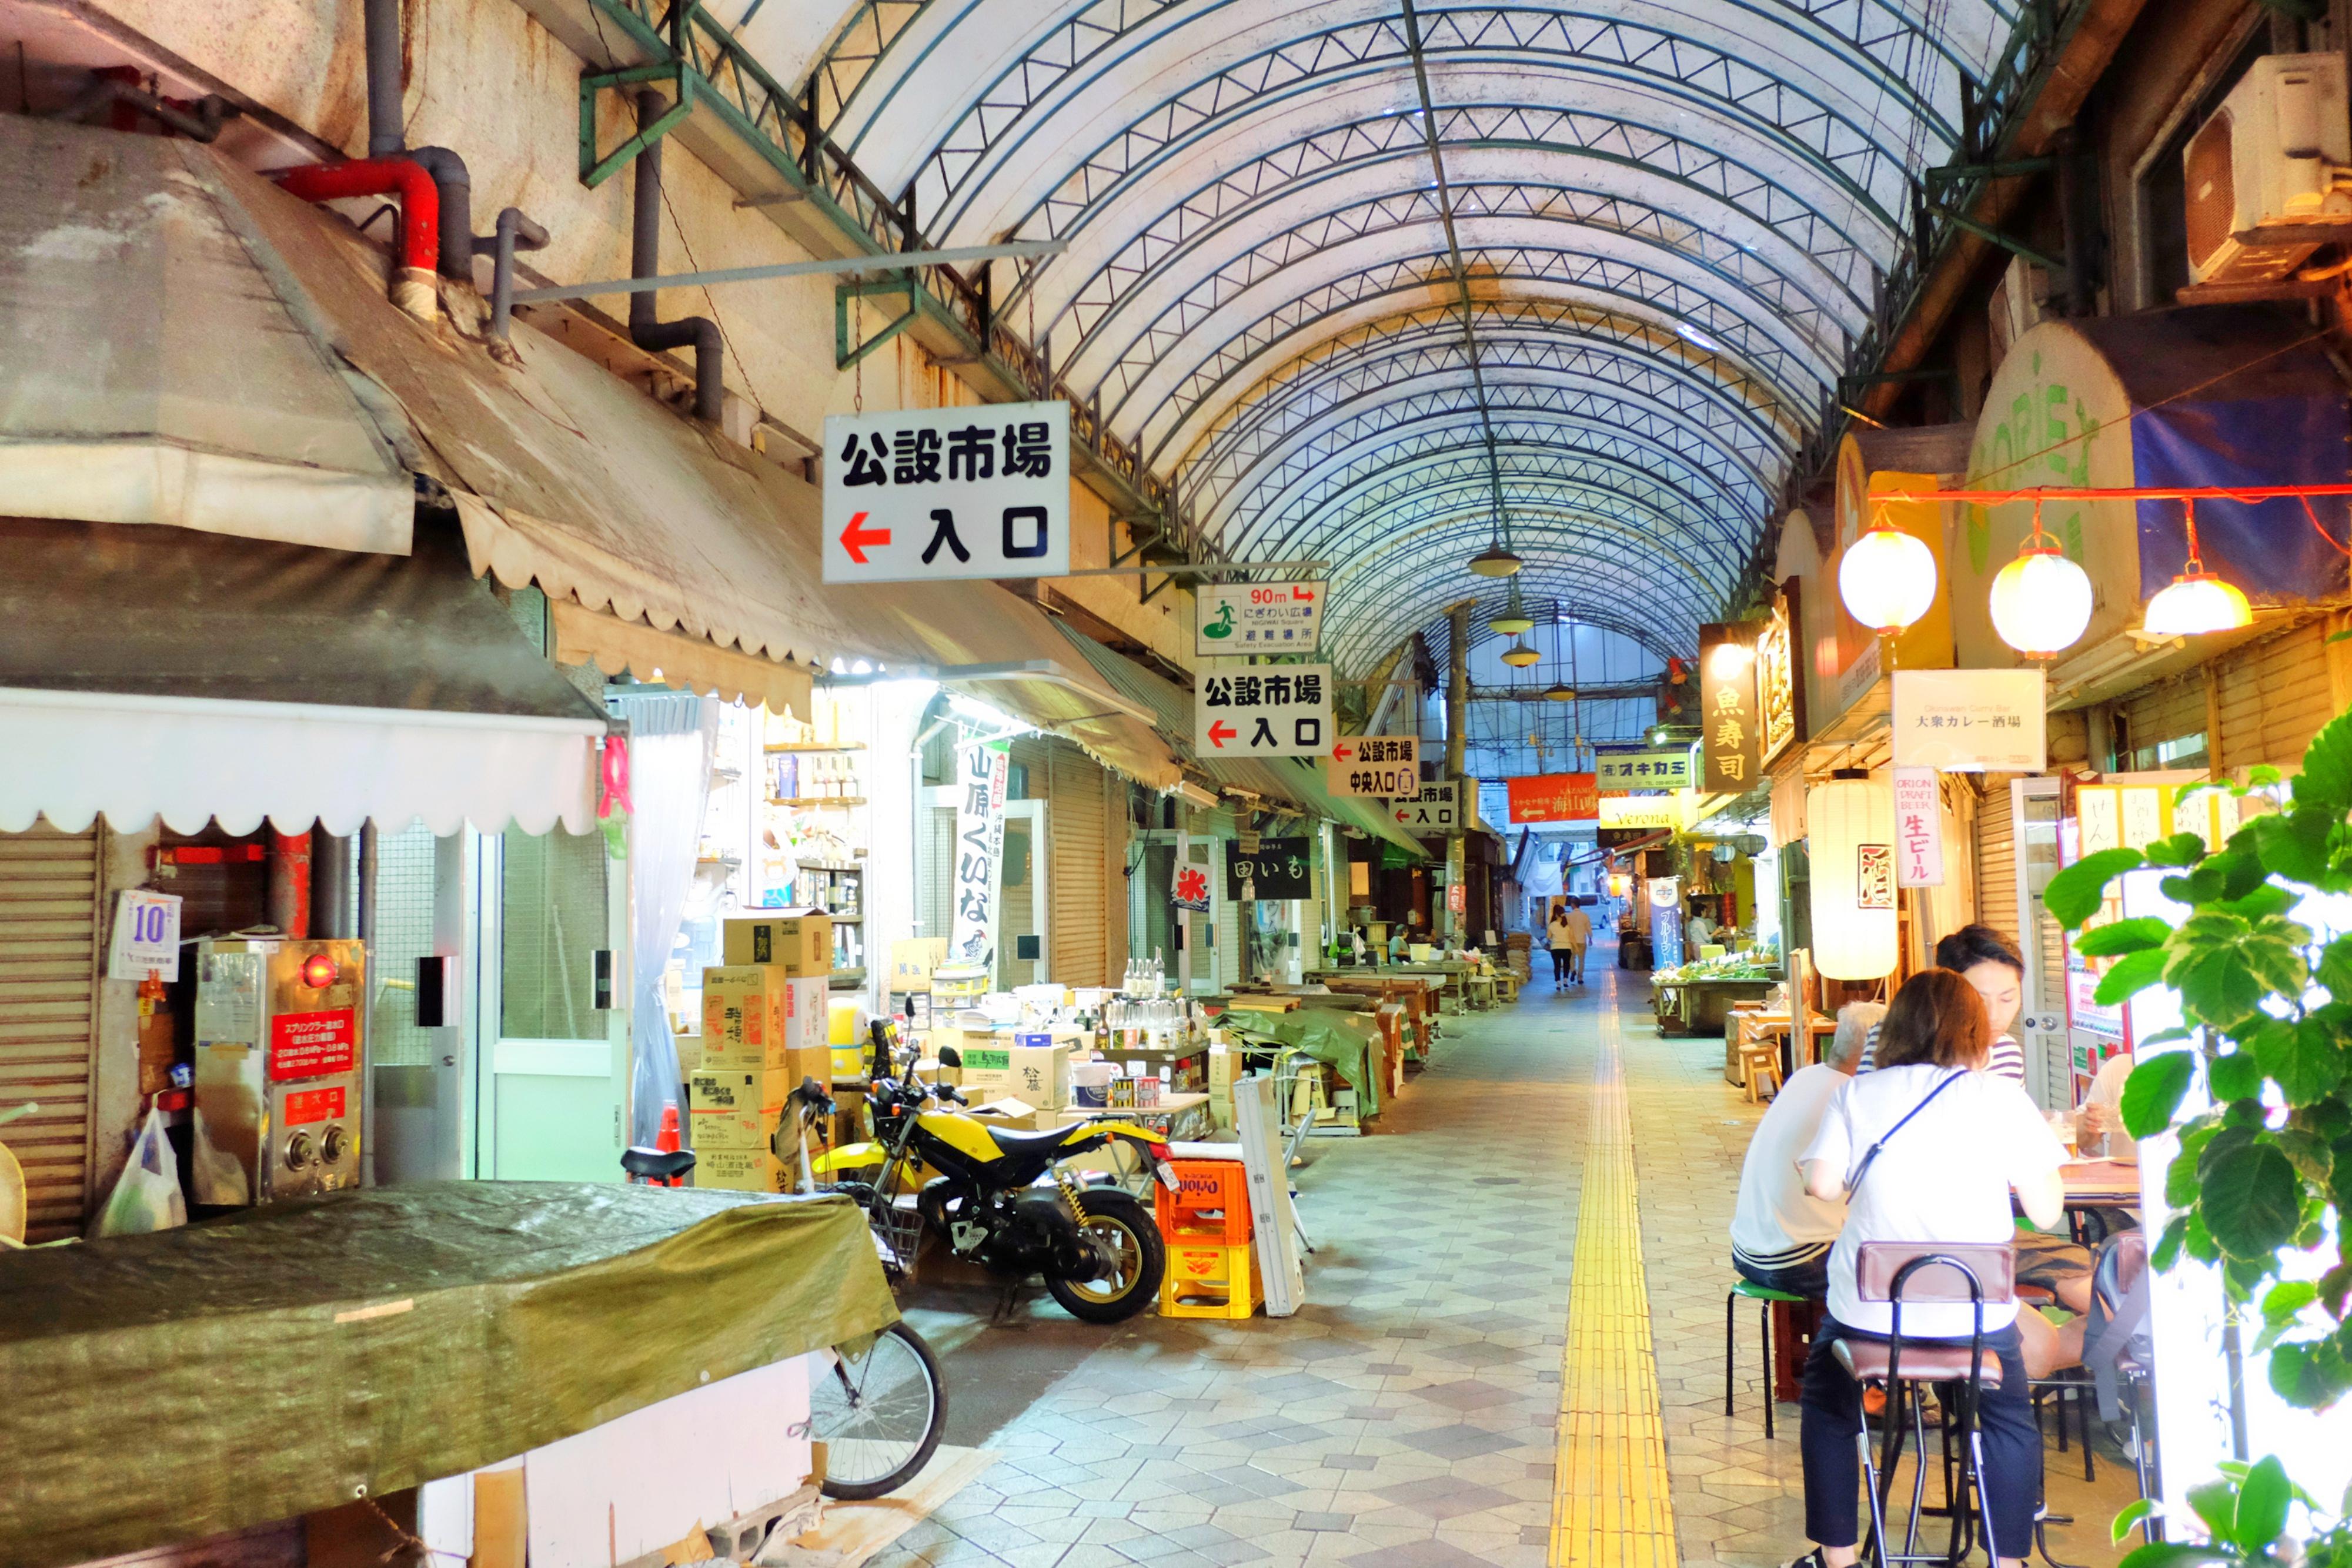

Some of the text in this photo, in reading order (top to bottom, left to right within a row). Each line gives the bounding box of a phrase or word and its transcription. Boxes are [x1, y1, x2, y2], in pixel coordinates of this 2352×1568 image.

[841, 422, 1051, 487] 公設市場
[921, 506, 1048, 564] 入口
[1251, 589, 1287, 604] 90m
[1244, 607, 1312, 618] にぎわい広場
[1245, 628, 1312, 641] 避難場所
[1205, 674, 1322, 707] 公設市場
[1251, 717, 1320, 747] 入口
[1712, 684, 1745, 781] 魚寿司
[1915, 715, 2021, 728] 大衆カレー酒場
[1358, 741, 1412, 762] 公設市場
[1350, 770, 1395, 793] 中央入口
[1897, 779, 1932, 788] ORION
[1900, 791, 1932, 800] DRAFT
[1900, 801, 1932, 810] BEER
[1416, 808, 1452, 823] 入口
[1615, 813, 1669, 825] Verona
[960, 744, 991, 924] 山原くいな
[1904, 814, 1930, 880] 生ビール
[1234, 854, 1304, 880] 田いも
[1177, 869, 1205, 902] 氷
[134, 904, 166, 943] 10
[1023, 1066, 1044, 1091] 松藤
